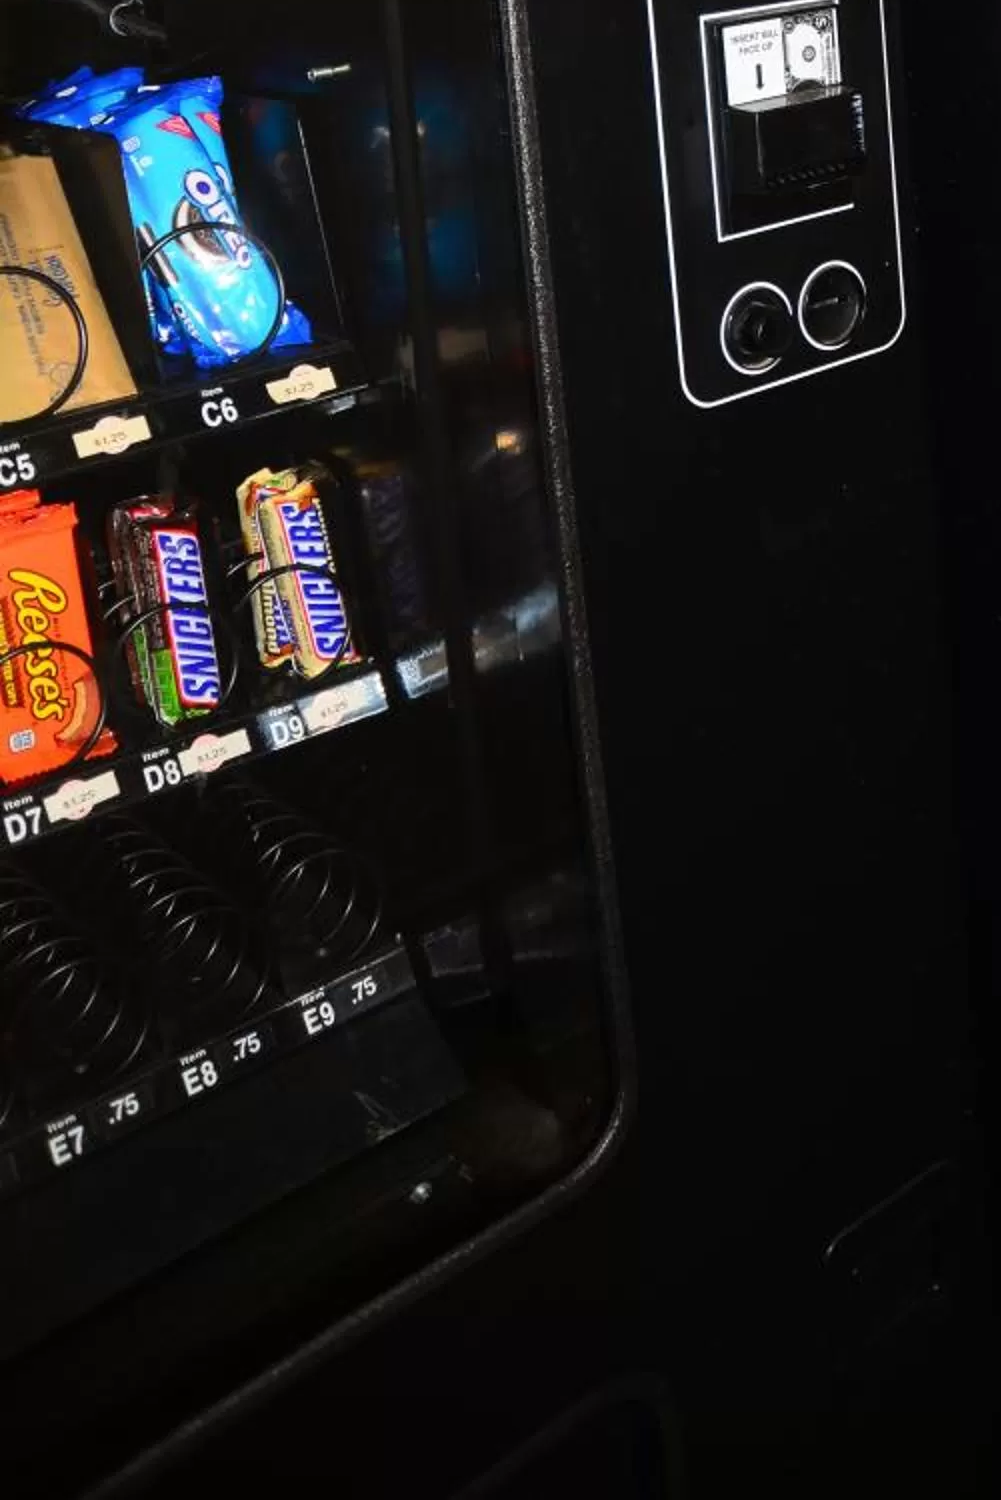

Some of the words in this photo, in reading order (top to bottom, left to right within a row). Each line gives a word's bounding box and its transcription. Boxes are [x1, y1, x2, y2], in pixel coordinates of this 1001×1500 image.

[201, 396, 239, 427] C6
[0, 453, 35, 487] C5
[157, 532, 220, 700] SNICKERS
[8, 567, 71, 722] Reese's
[269, 715, 305, 747] D9
[143, 758, 181, 794] D8
[3, 794, 34, 811] Item
[3, 805, 41, 844] D7
[350, 974, 377, 1005] .75
[302, 1000, 336, 1036] E9
[232, 1030, 261, 1062] .75
[181, 1059, 219, 1097] E8
[108, 1091, 140, 1126] .75
[48, 1124, 85, 1167] E7
